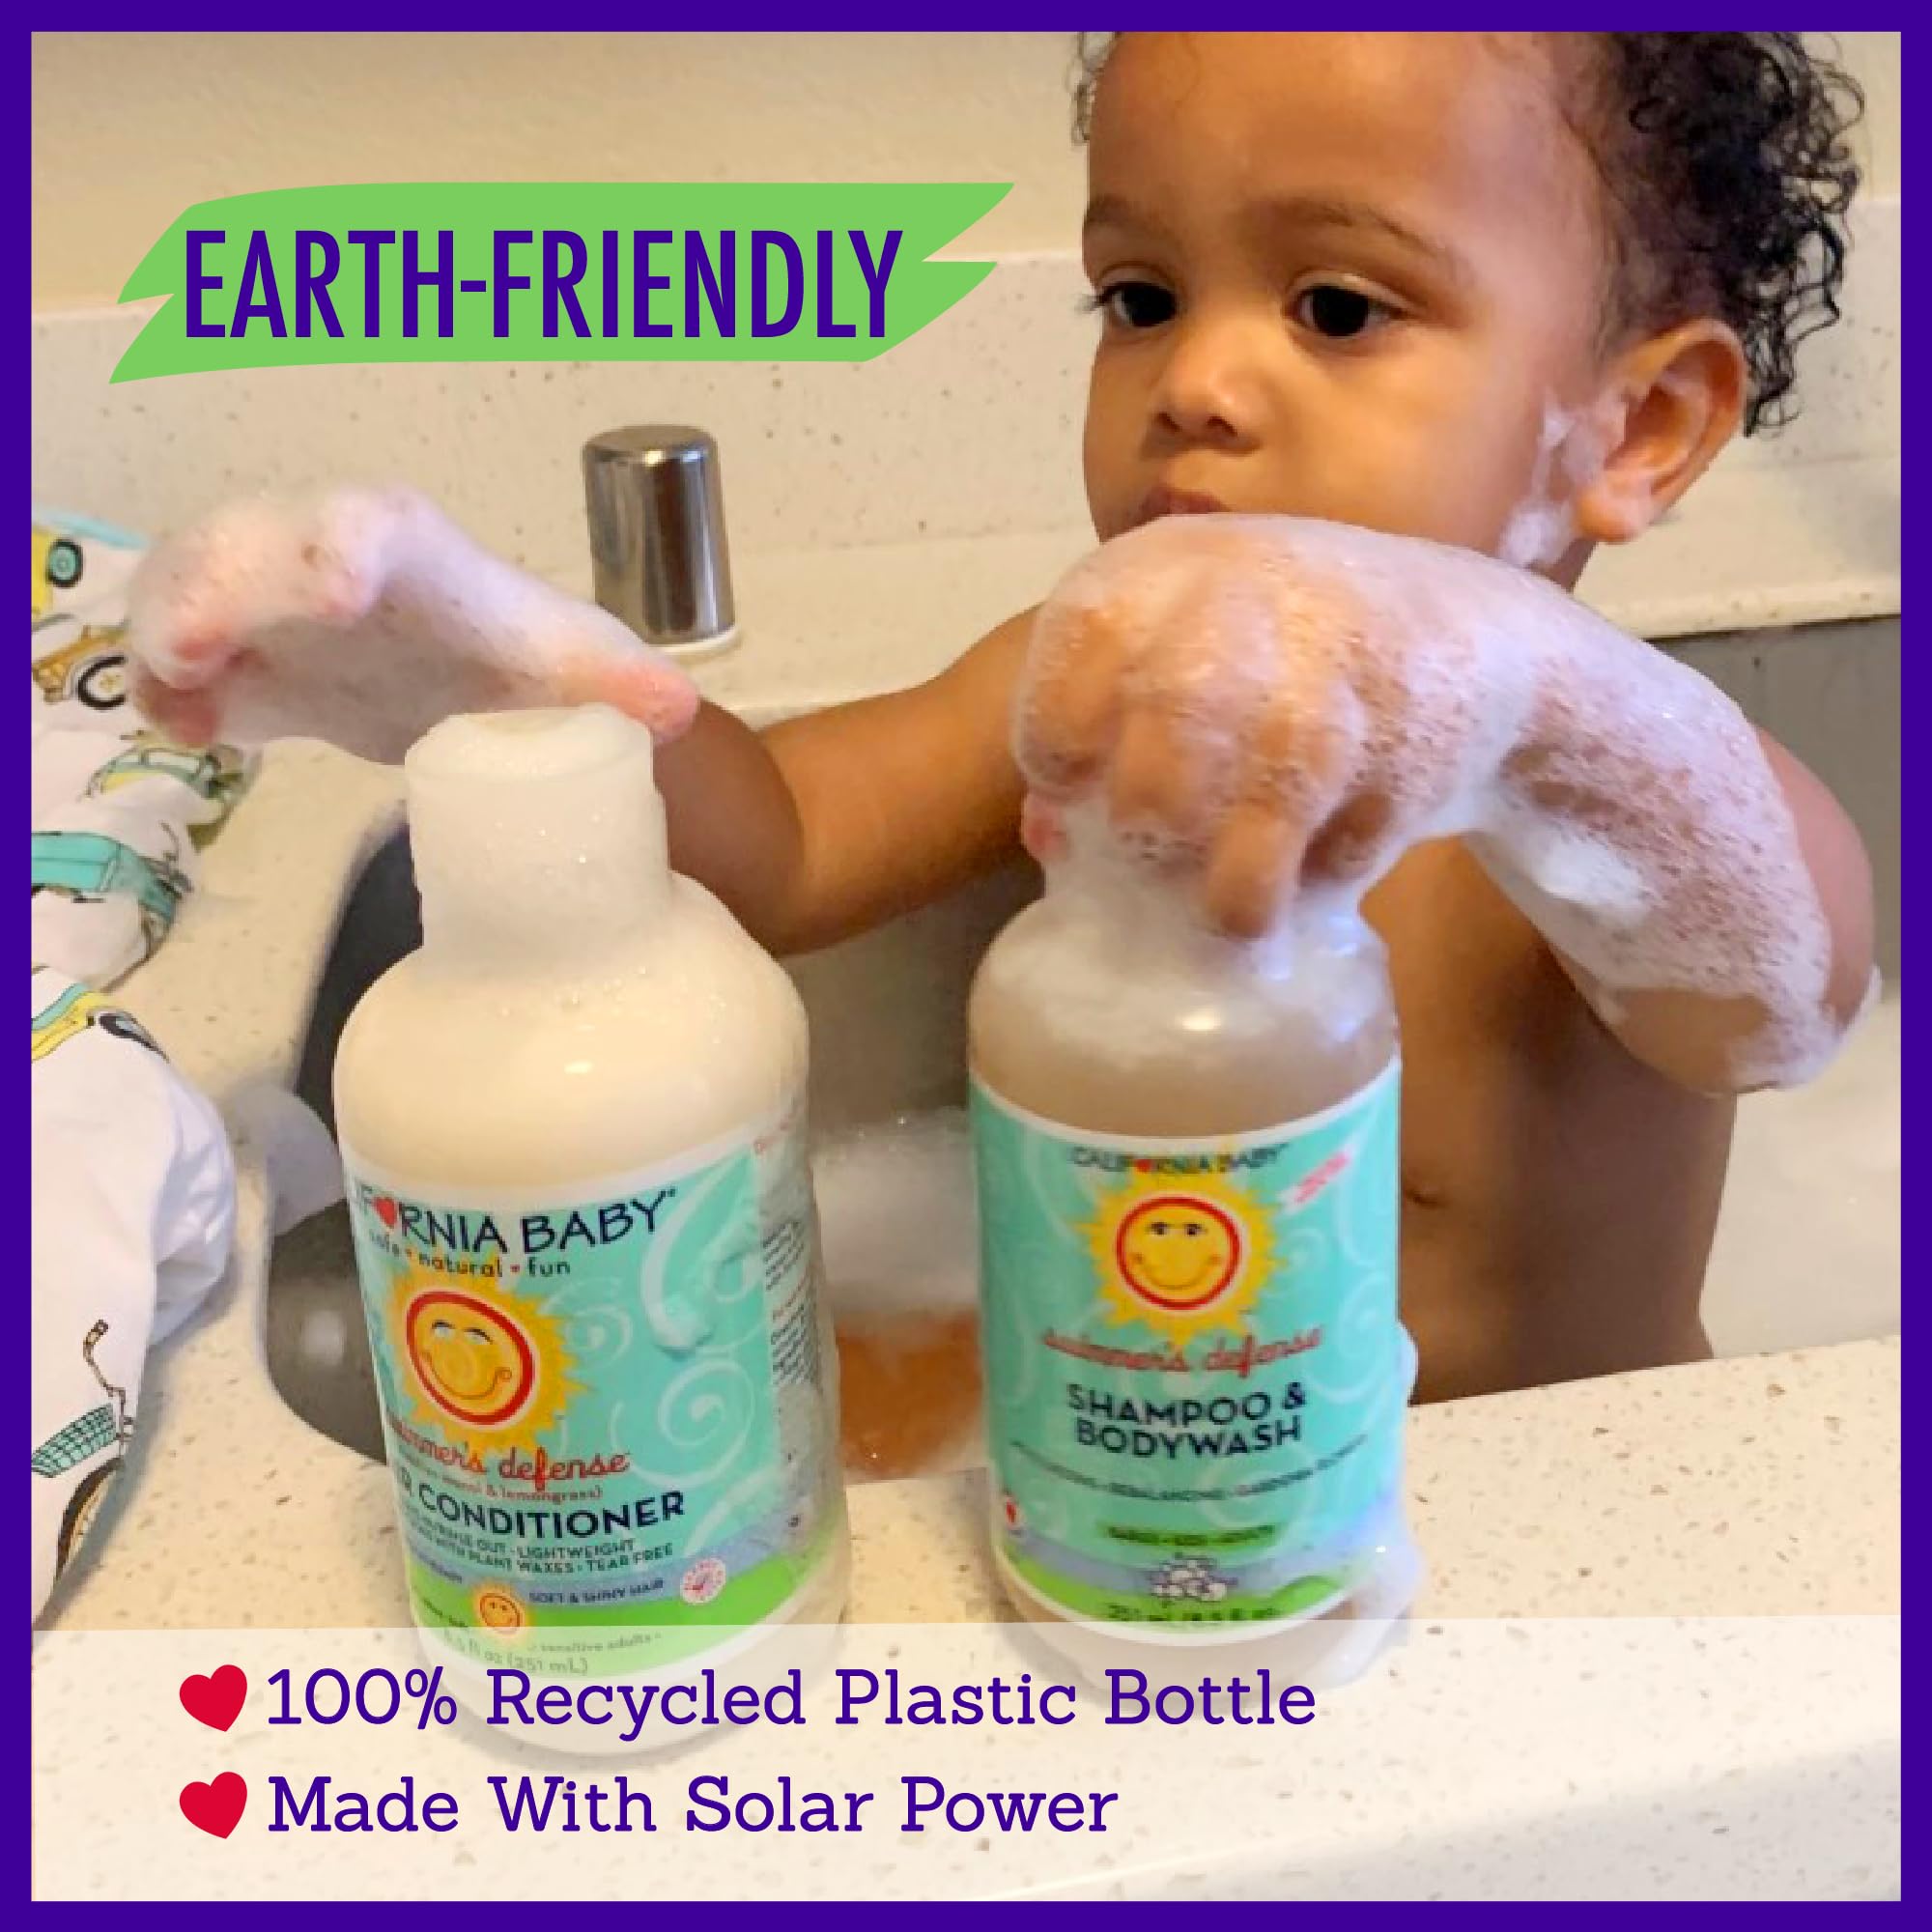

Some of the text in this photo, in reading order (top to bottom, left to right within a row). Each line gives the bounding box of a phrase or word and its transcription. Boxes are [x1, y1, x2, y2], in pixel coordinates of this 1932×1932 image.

[520, 1190, 667, 1255] BABY
[419, 1252, 503, 1278] natural
[527, 1256, 572, 1277] fun
[1066, 1381, 1306, 1428] SHAMPOO &
[1075, 1415, 1301, 1459] BODYWASH
[498, 1446, 631, 1492] defense
[418, 1481, 686, 1539] CONDITIONER
[632, 1541, 674, 1566] FREE
